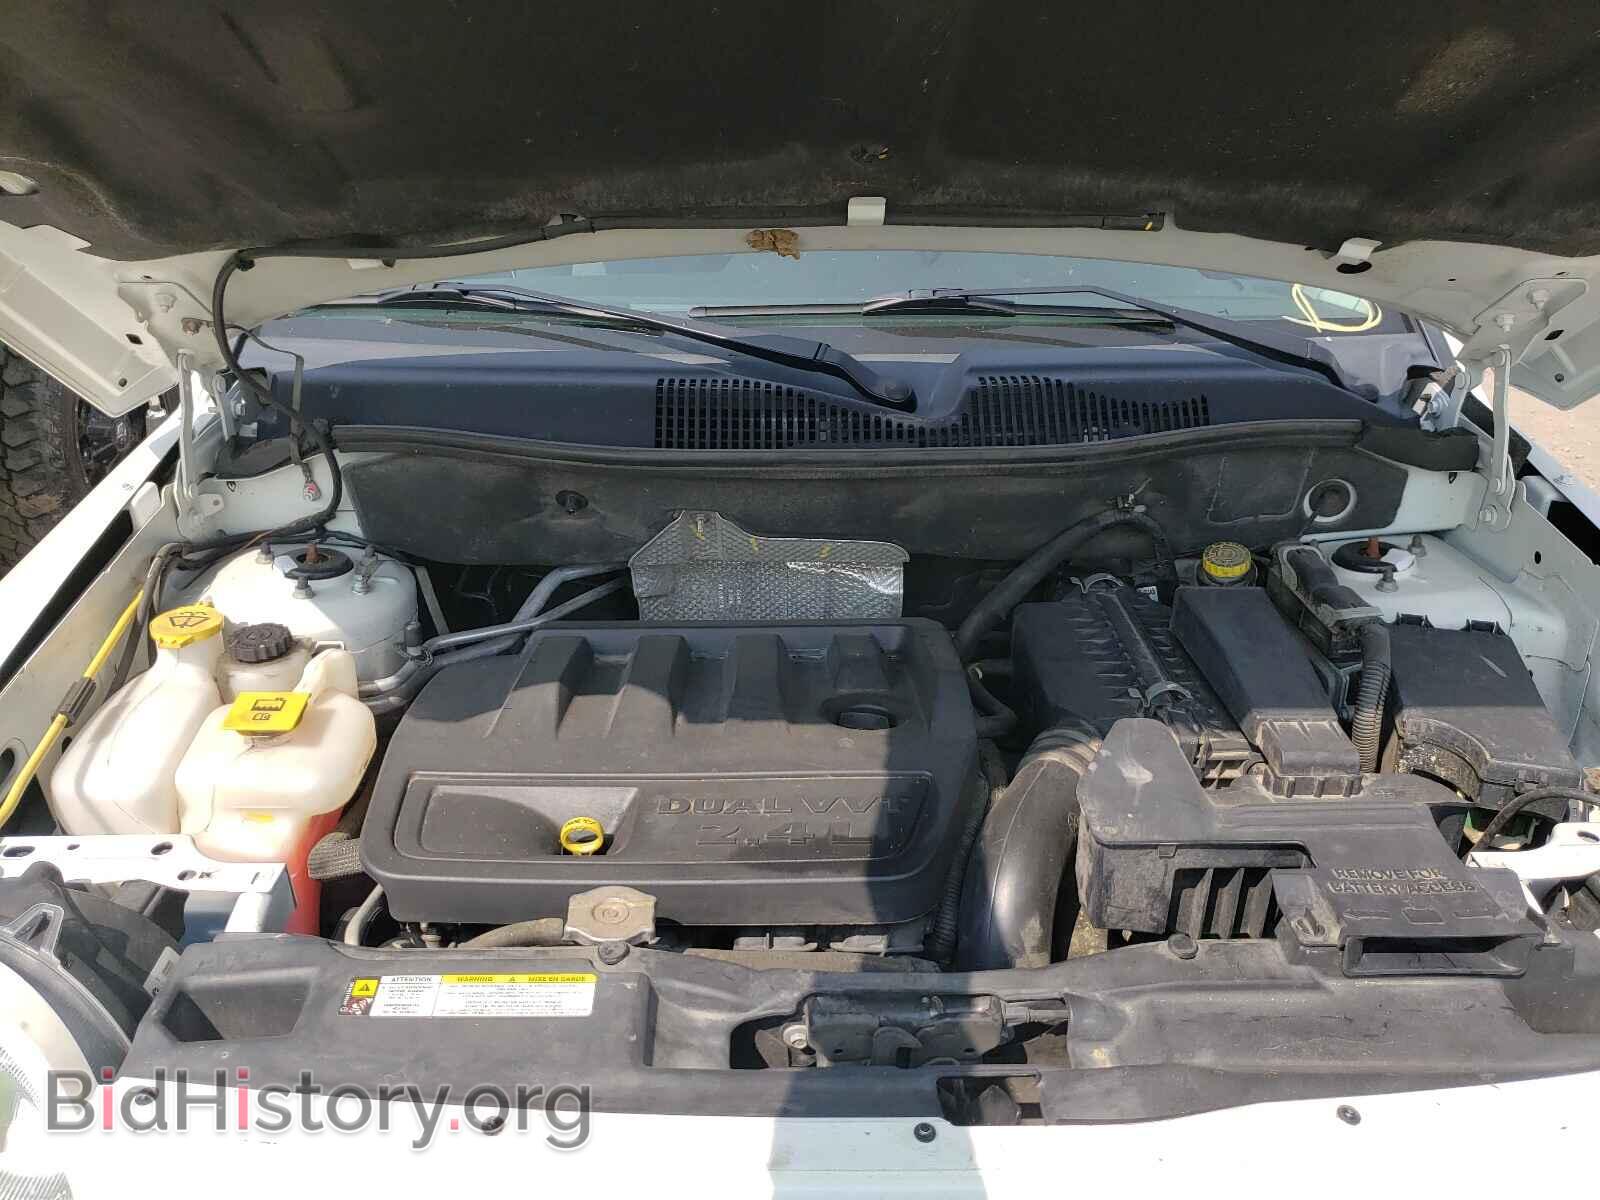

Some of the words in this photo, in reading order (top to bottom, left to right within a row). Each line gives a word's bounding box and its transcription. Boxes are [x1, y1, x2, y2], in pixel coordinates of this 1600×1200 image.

[656, 797, 793, 816] DUAL
[696, 822, 873, 846] 2.4L
[1331, 867, 1405, 881] REMOVE
[1407, 867, 1449, 881] FOR
[1327, 880, 1404, 895] BATTERY
[1405, 880, 1479, 895] ACCESS
[391, 975, 433, 983] ATTENTION
[456, 975, 494, 983] WARNING
[560, 975, 587, 983] GARDE
